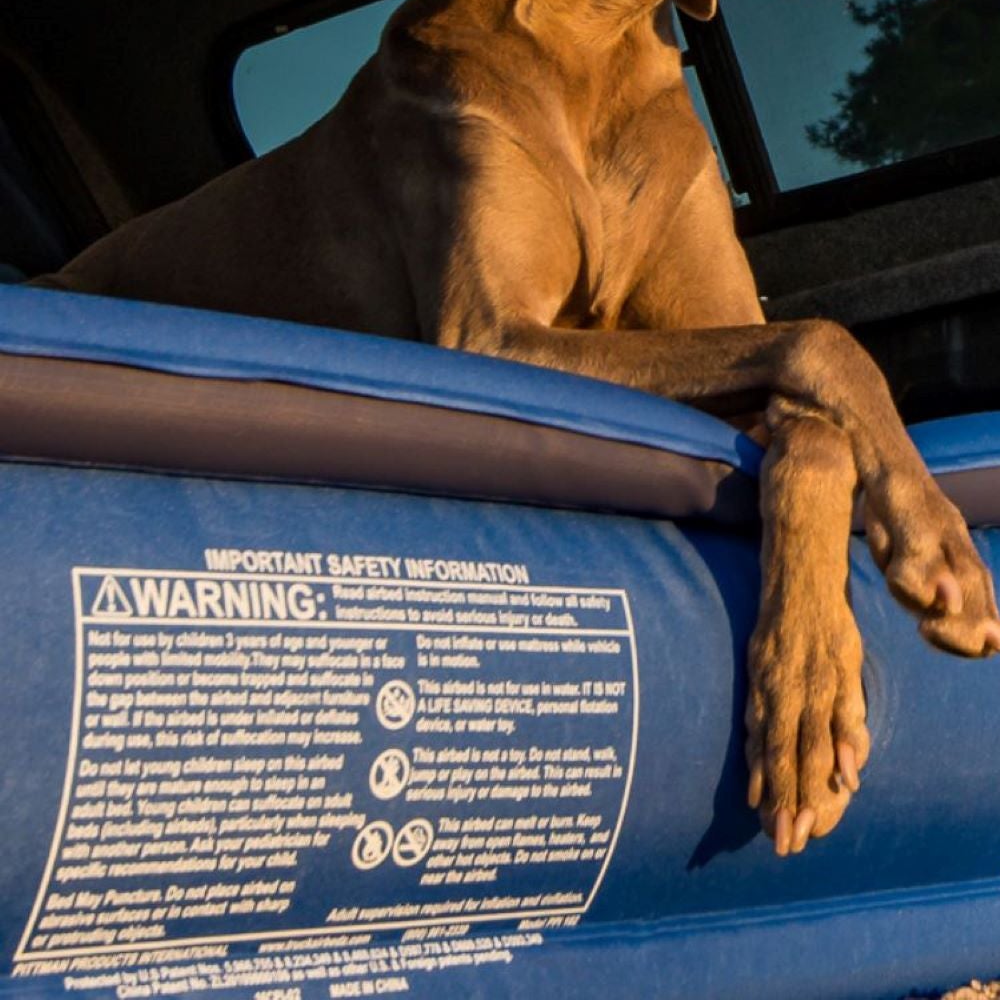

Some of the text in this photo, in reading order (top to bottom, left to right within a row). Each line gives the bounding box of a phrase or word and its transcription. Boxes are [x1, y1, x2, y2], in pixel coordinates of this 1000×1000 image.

[204, 548, 529, 585] IMPORTANT SAFETY INFORMATION
[129, 577, 329, 620] WARNING:
